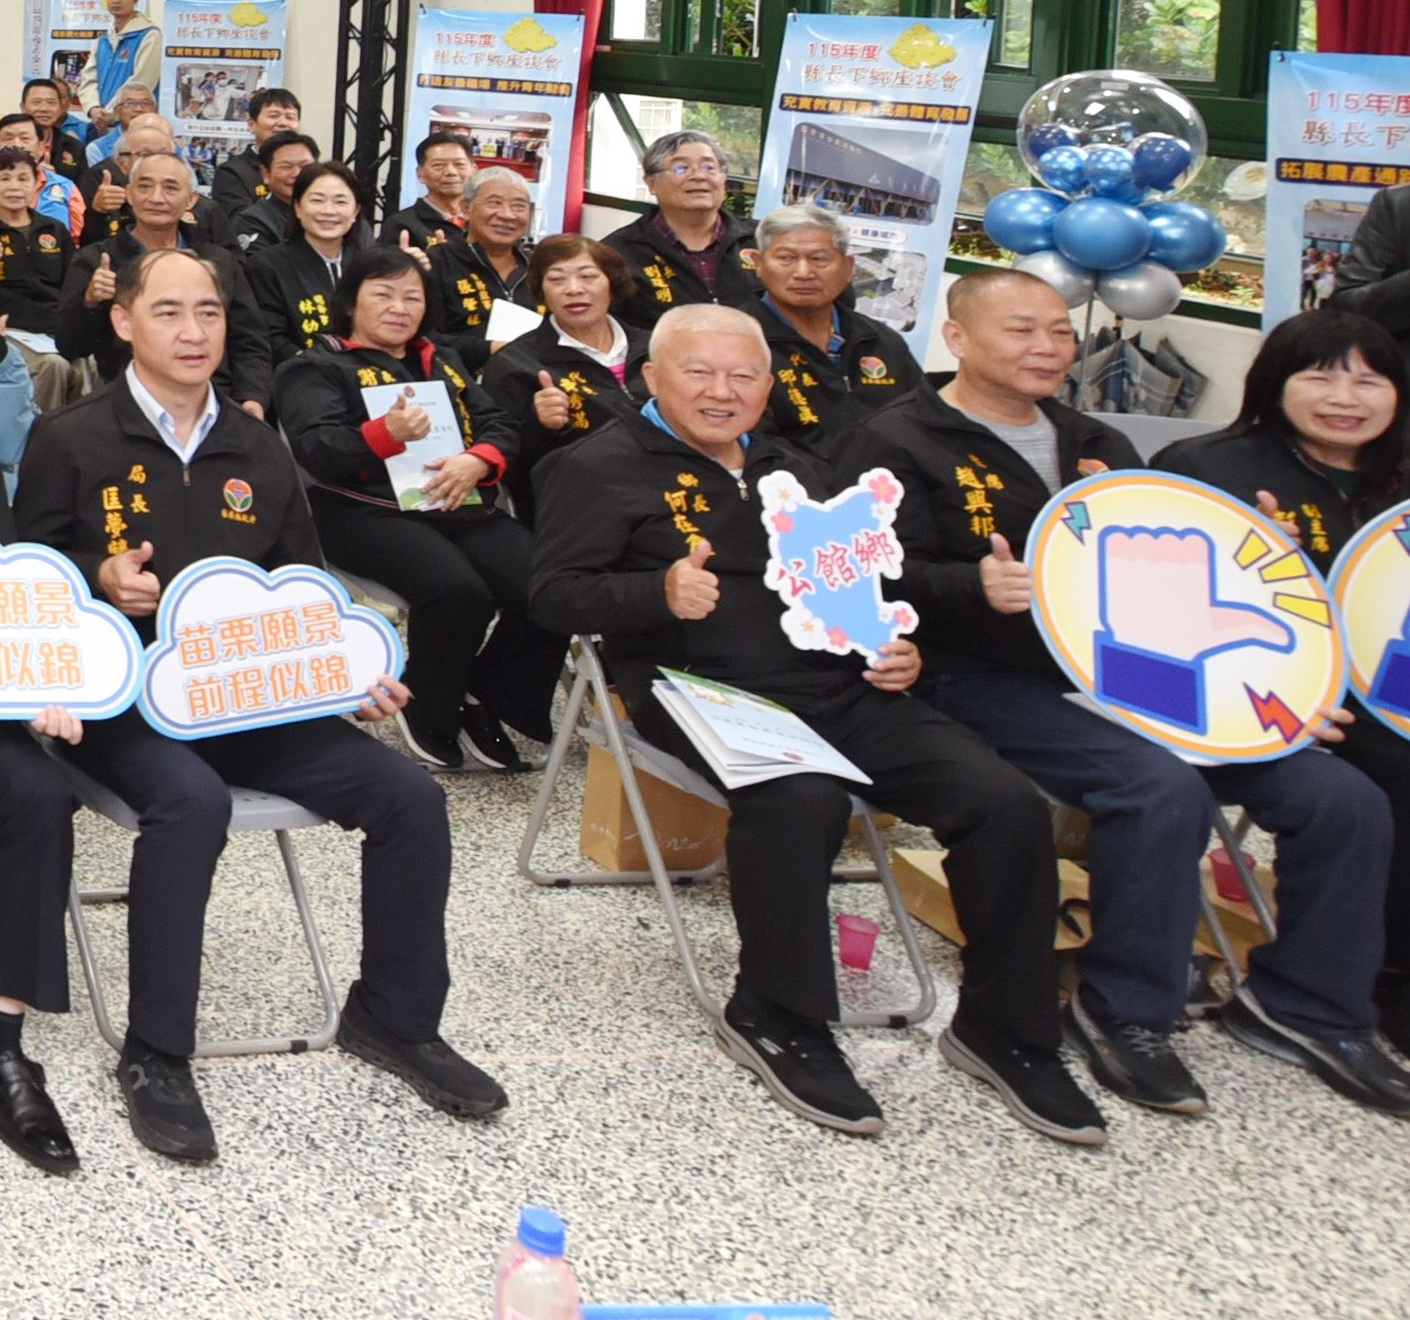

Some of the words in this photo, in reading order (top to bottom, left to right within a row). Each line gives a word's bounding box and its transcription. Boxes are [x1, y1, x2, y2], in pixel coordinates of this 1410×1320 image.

[436, 31, 495, 47] 115年度
[808, 41, 881, 60] 115年度
[805, 64, 963, 92] 縣長下鄉座談會
[1307, 89, 1410, 115] 115年度
[126, 463, 152, 516] 局長
[777, 531, 896, 598] 公館鄉
[175, 600, 345, 669] 苗栗願景
[185, 653, 355, 721] 前程似錦
